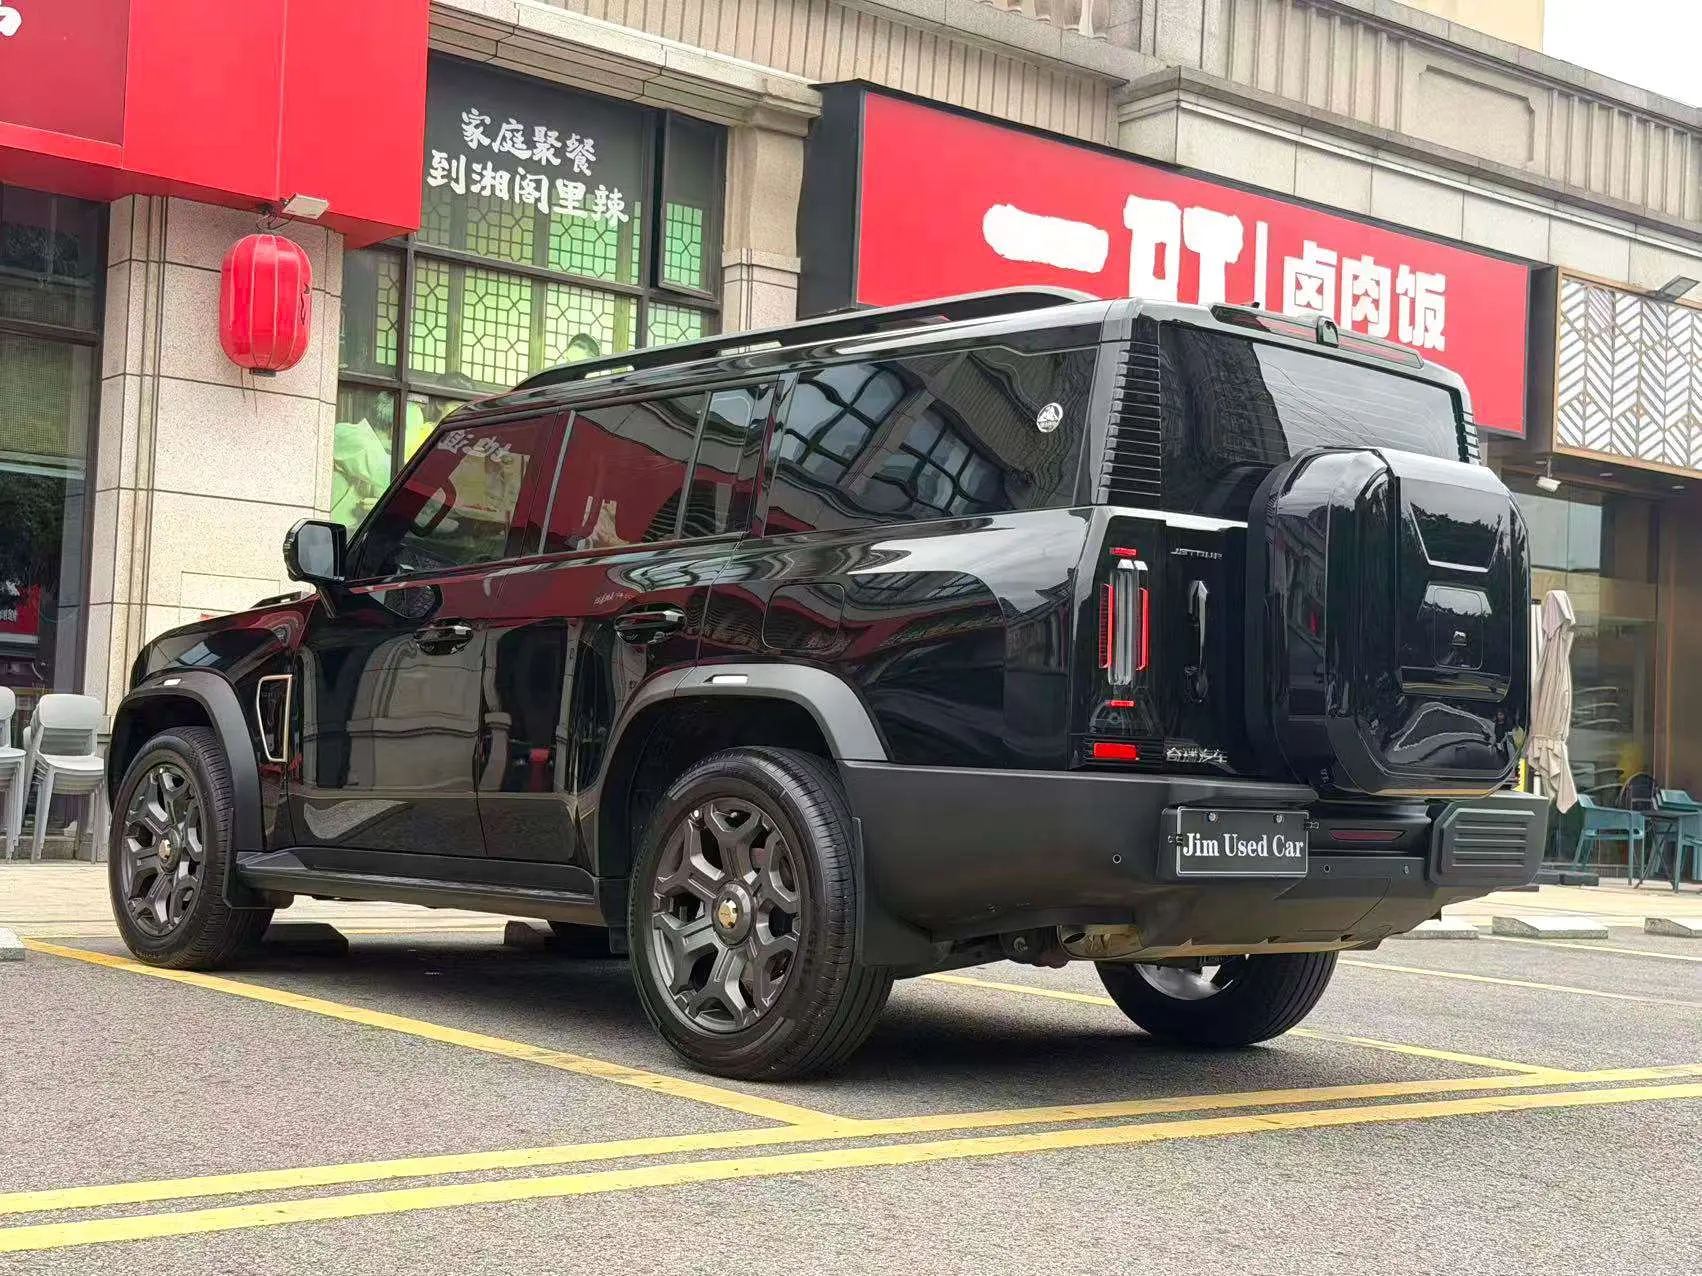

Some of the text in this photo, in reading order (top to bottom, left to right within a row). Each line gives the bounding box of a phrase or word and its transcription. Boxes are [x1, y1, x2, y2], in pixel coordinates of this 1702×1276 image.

[461, 107, 597, 176] 家庭聚餐
[426, 149, 630, 229] 到湘阁里辣
[1282, 239, 1448, 352] 卤肉饭
[1182, 832, 1304, 857] Jim Used Car
